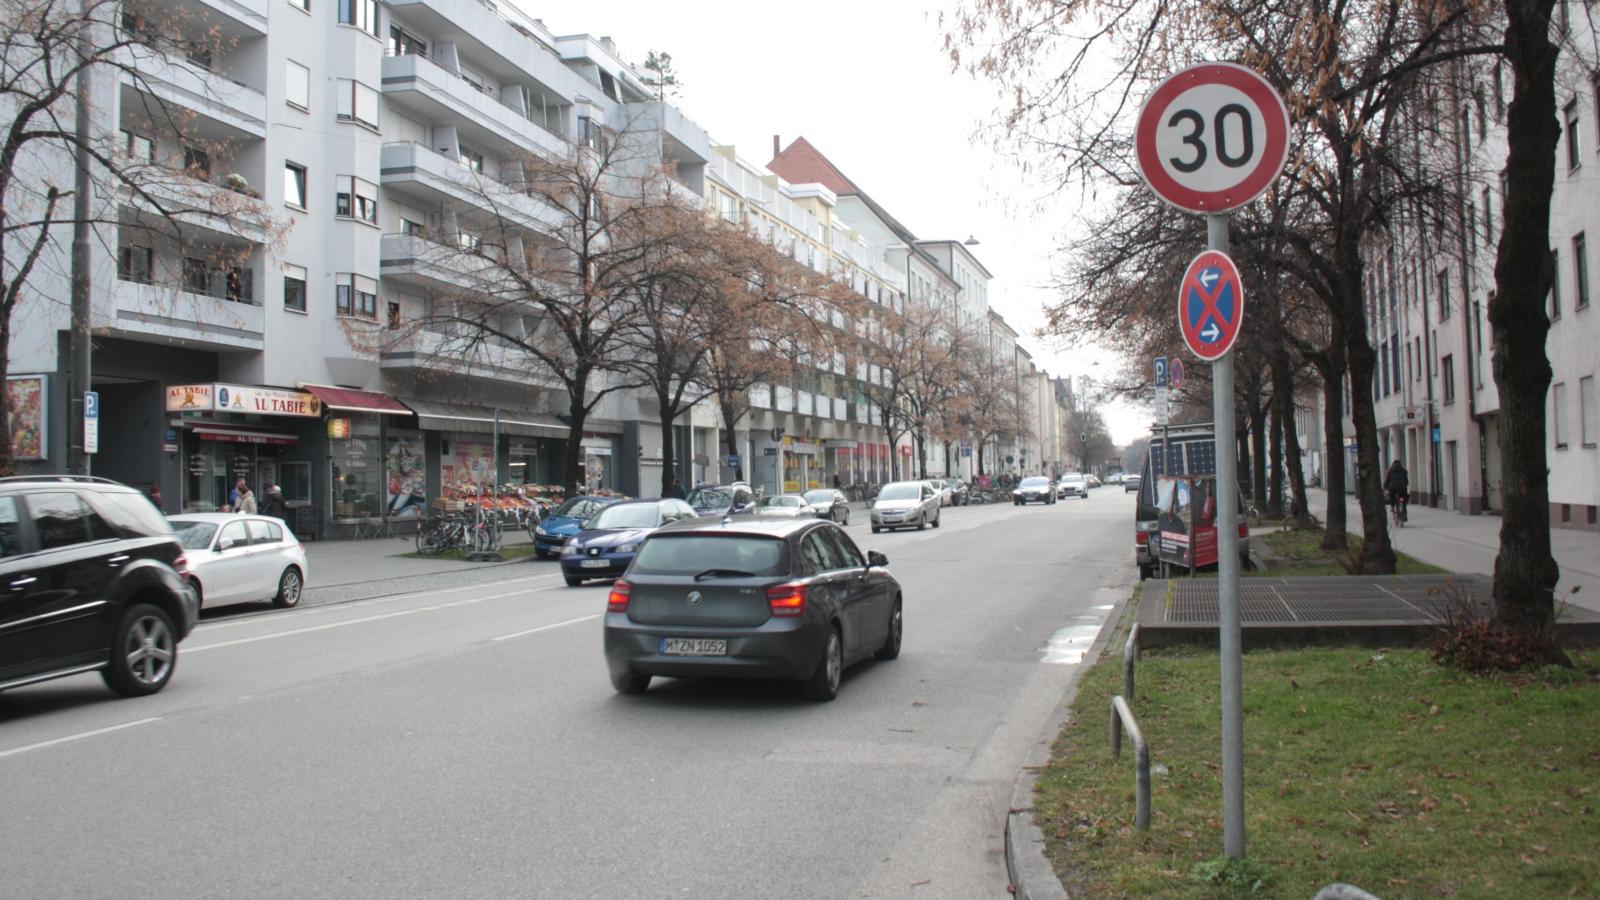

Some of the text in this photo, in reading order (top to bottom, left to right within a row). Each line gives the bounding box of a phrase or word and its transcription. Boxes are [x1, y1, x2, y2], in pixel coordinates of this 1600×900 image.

[1168, 103, 1254, 173] 30
[1156, 362, 1164, 384] P
[86, 395, 94, 415] P
